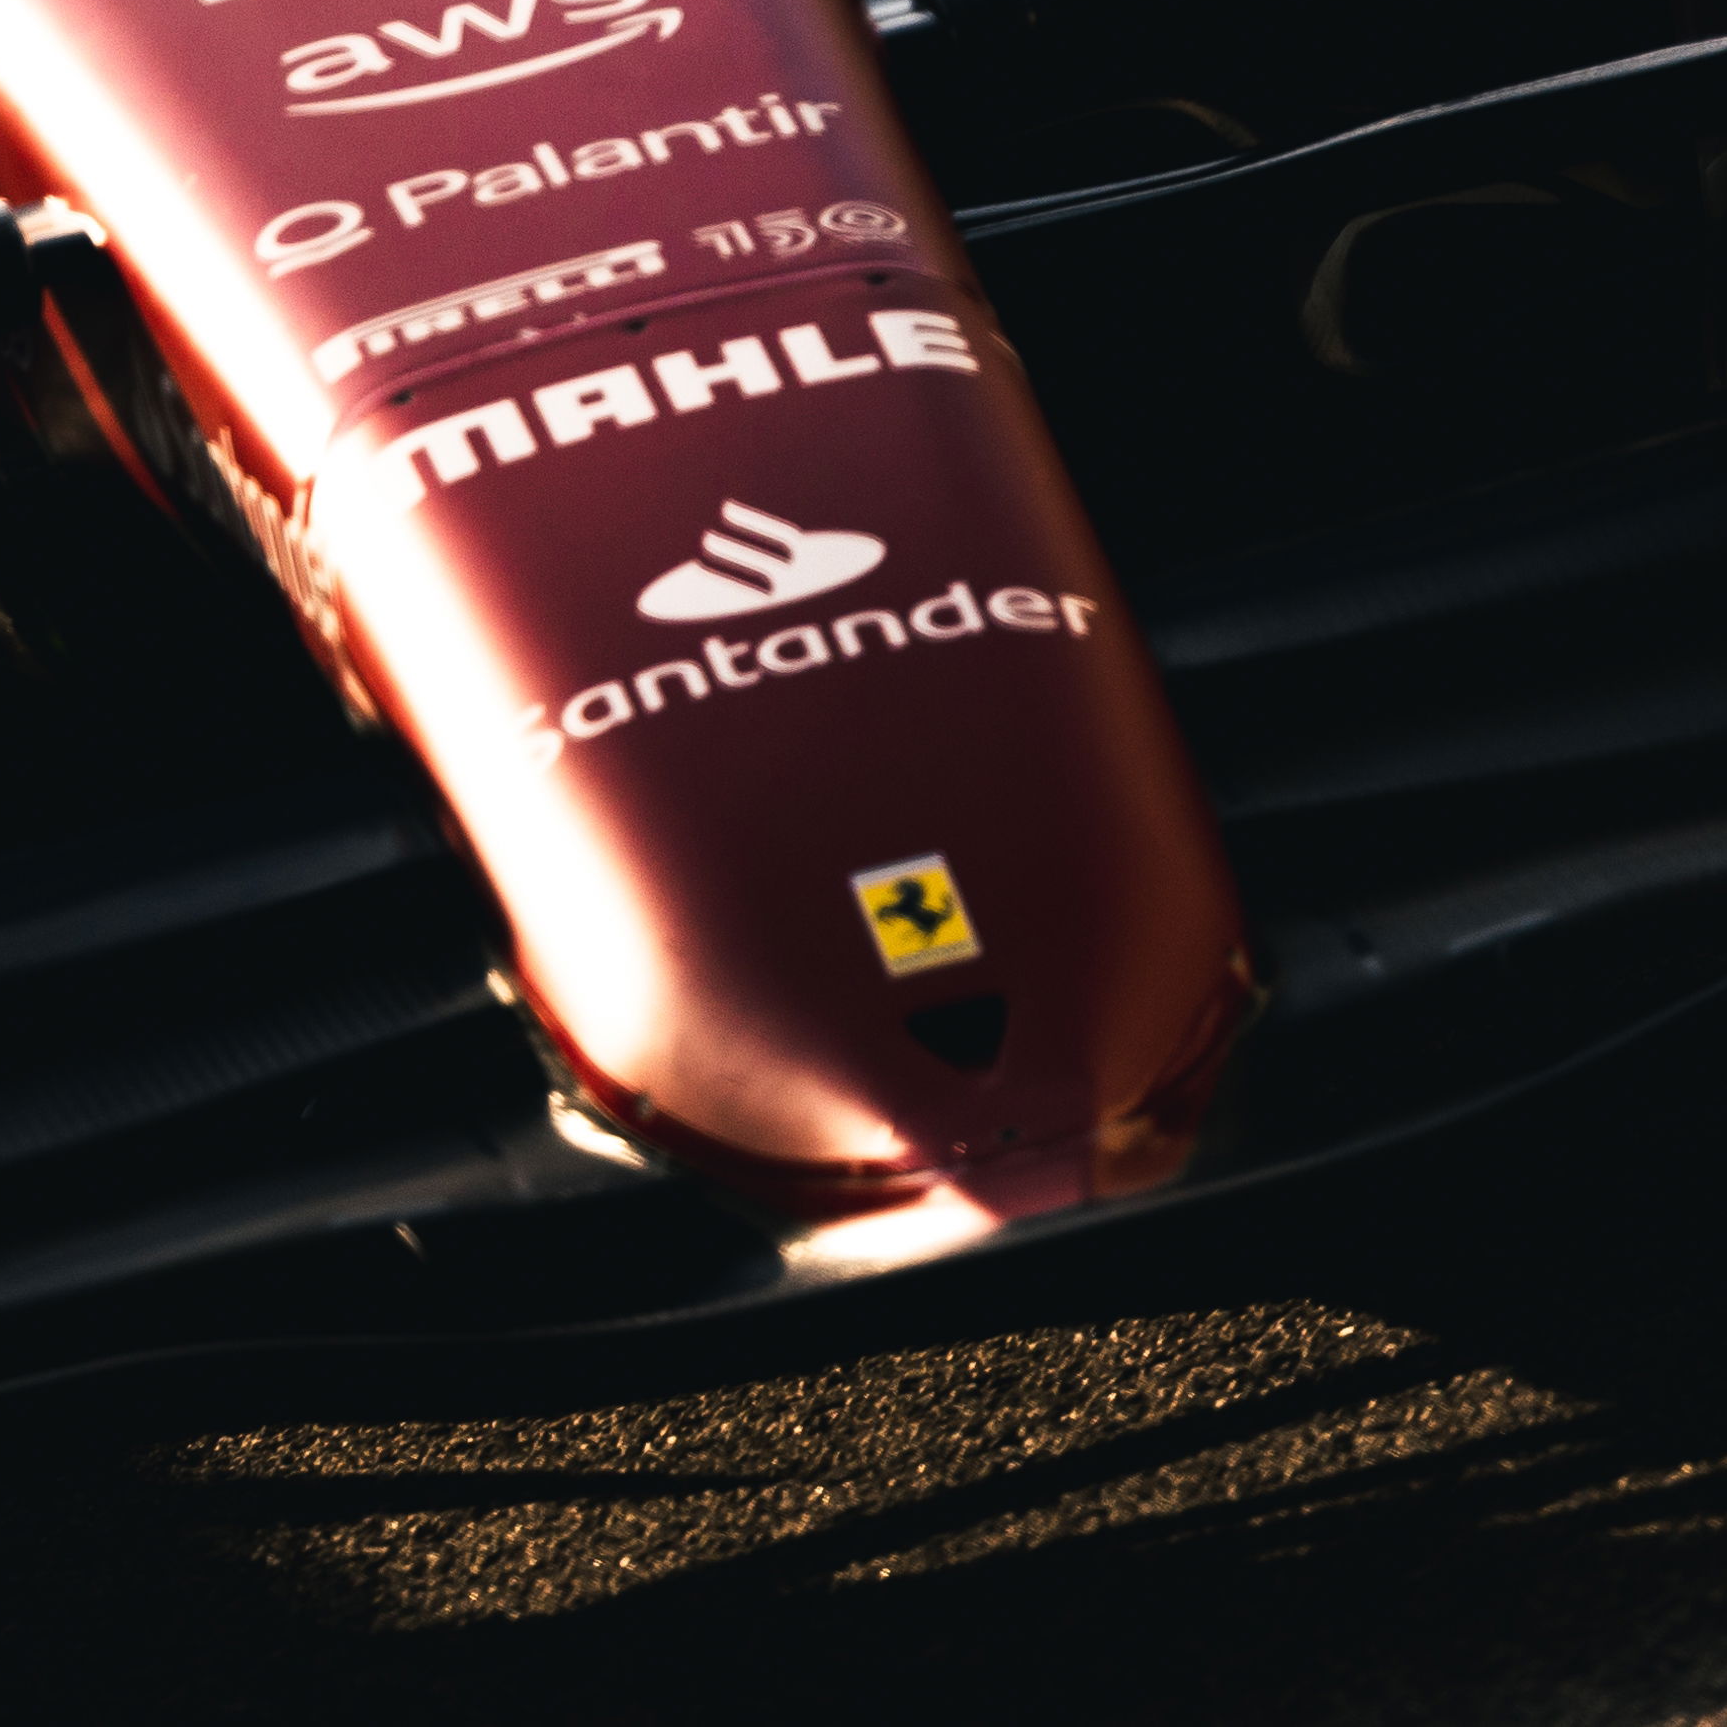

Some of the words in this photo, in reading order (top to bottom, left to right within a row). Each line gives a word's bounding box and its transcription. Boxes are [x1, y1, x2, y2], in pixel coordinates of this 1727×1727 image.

[385, 91, 843, 232] Palantir
[311, 238, 670, 385] PIRELLI
[358, 309, 981, 511] MAHLE
